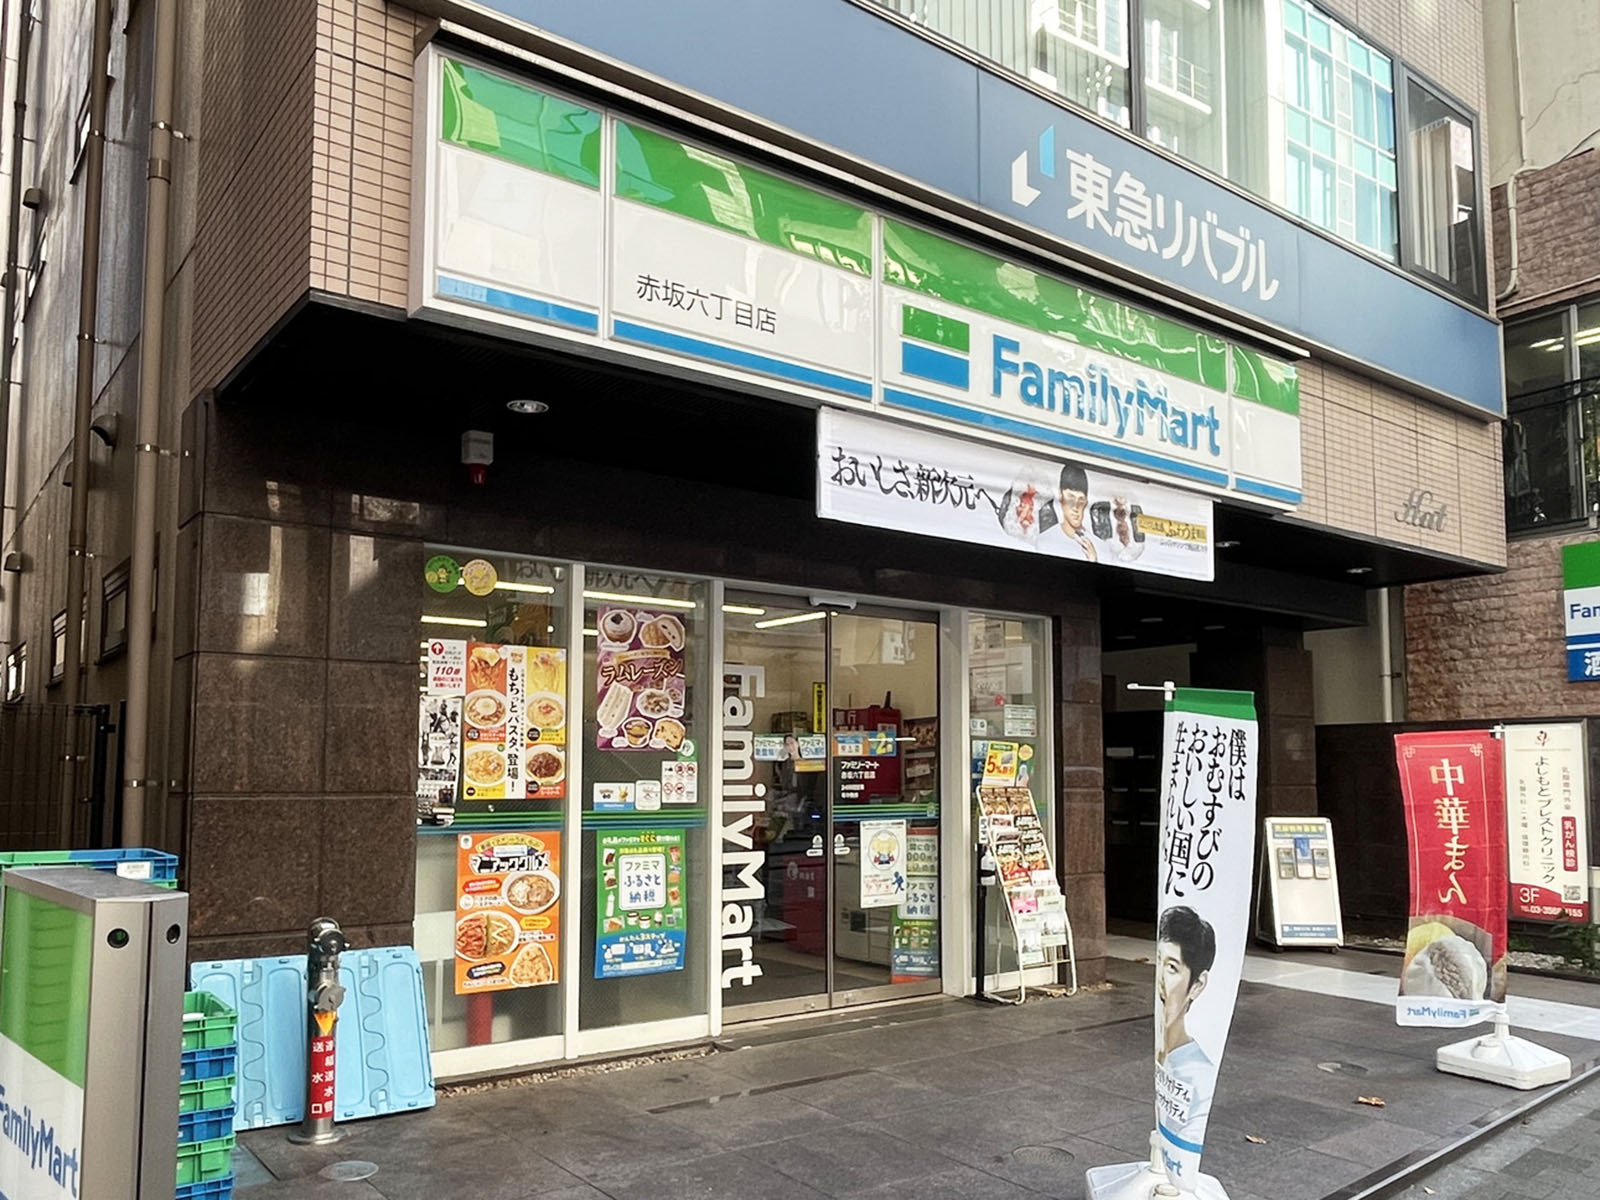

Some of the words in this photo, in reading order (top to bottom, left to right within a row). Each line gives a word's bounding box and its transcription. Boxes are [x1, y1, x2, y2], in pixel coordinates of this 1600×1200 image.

[1066, 147, 1280, 300] 東急リバブル
[636, 274, 777, 335] 赤坂六丁目店
[991, 333, 1221, 456] FamilyMart
[831, 446, 1003, 514] おいしさ新次元へ
[601, 658, 682, 687] ラムレーズン
[1228, 728, 1247, 801] 僕は
[723, 663, 765, 989] FamilyMart
[1165, 723, 1208, 897] おいしい国に
[1192, 726, 1227, 890] おむすびの
[1430, 758, 1470, 905] 中華まん
[471, 852, 549, 874] マニアックグルメ
[624, 860, 660, 872] ファミマ
[624, 874, 661, 887] ふるさと
[1519, 887, 1540, 903] 3F
[311, 1041, 324, 1114] 送水口
